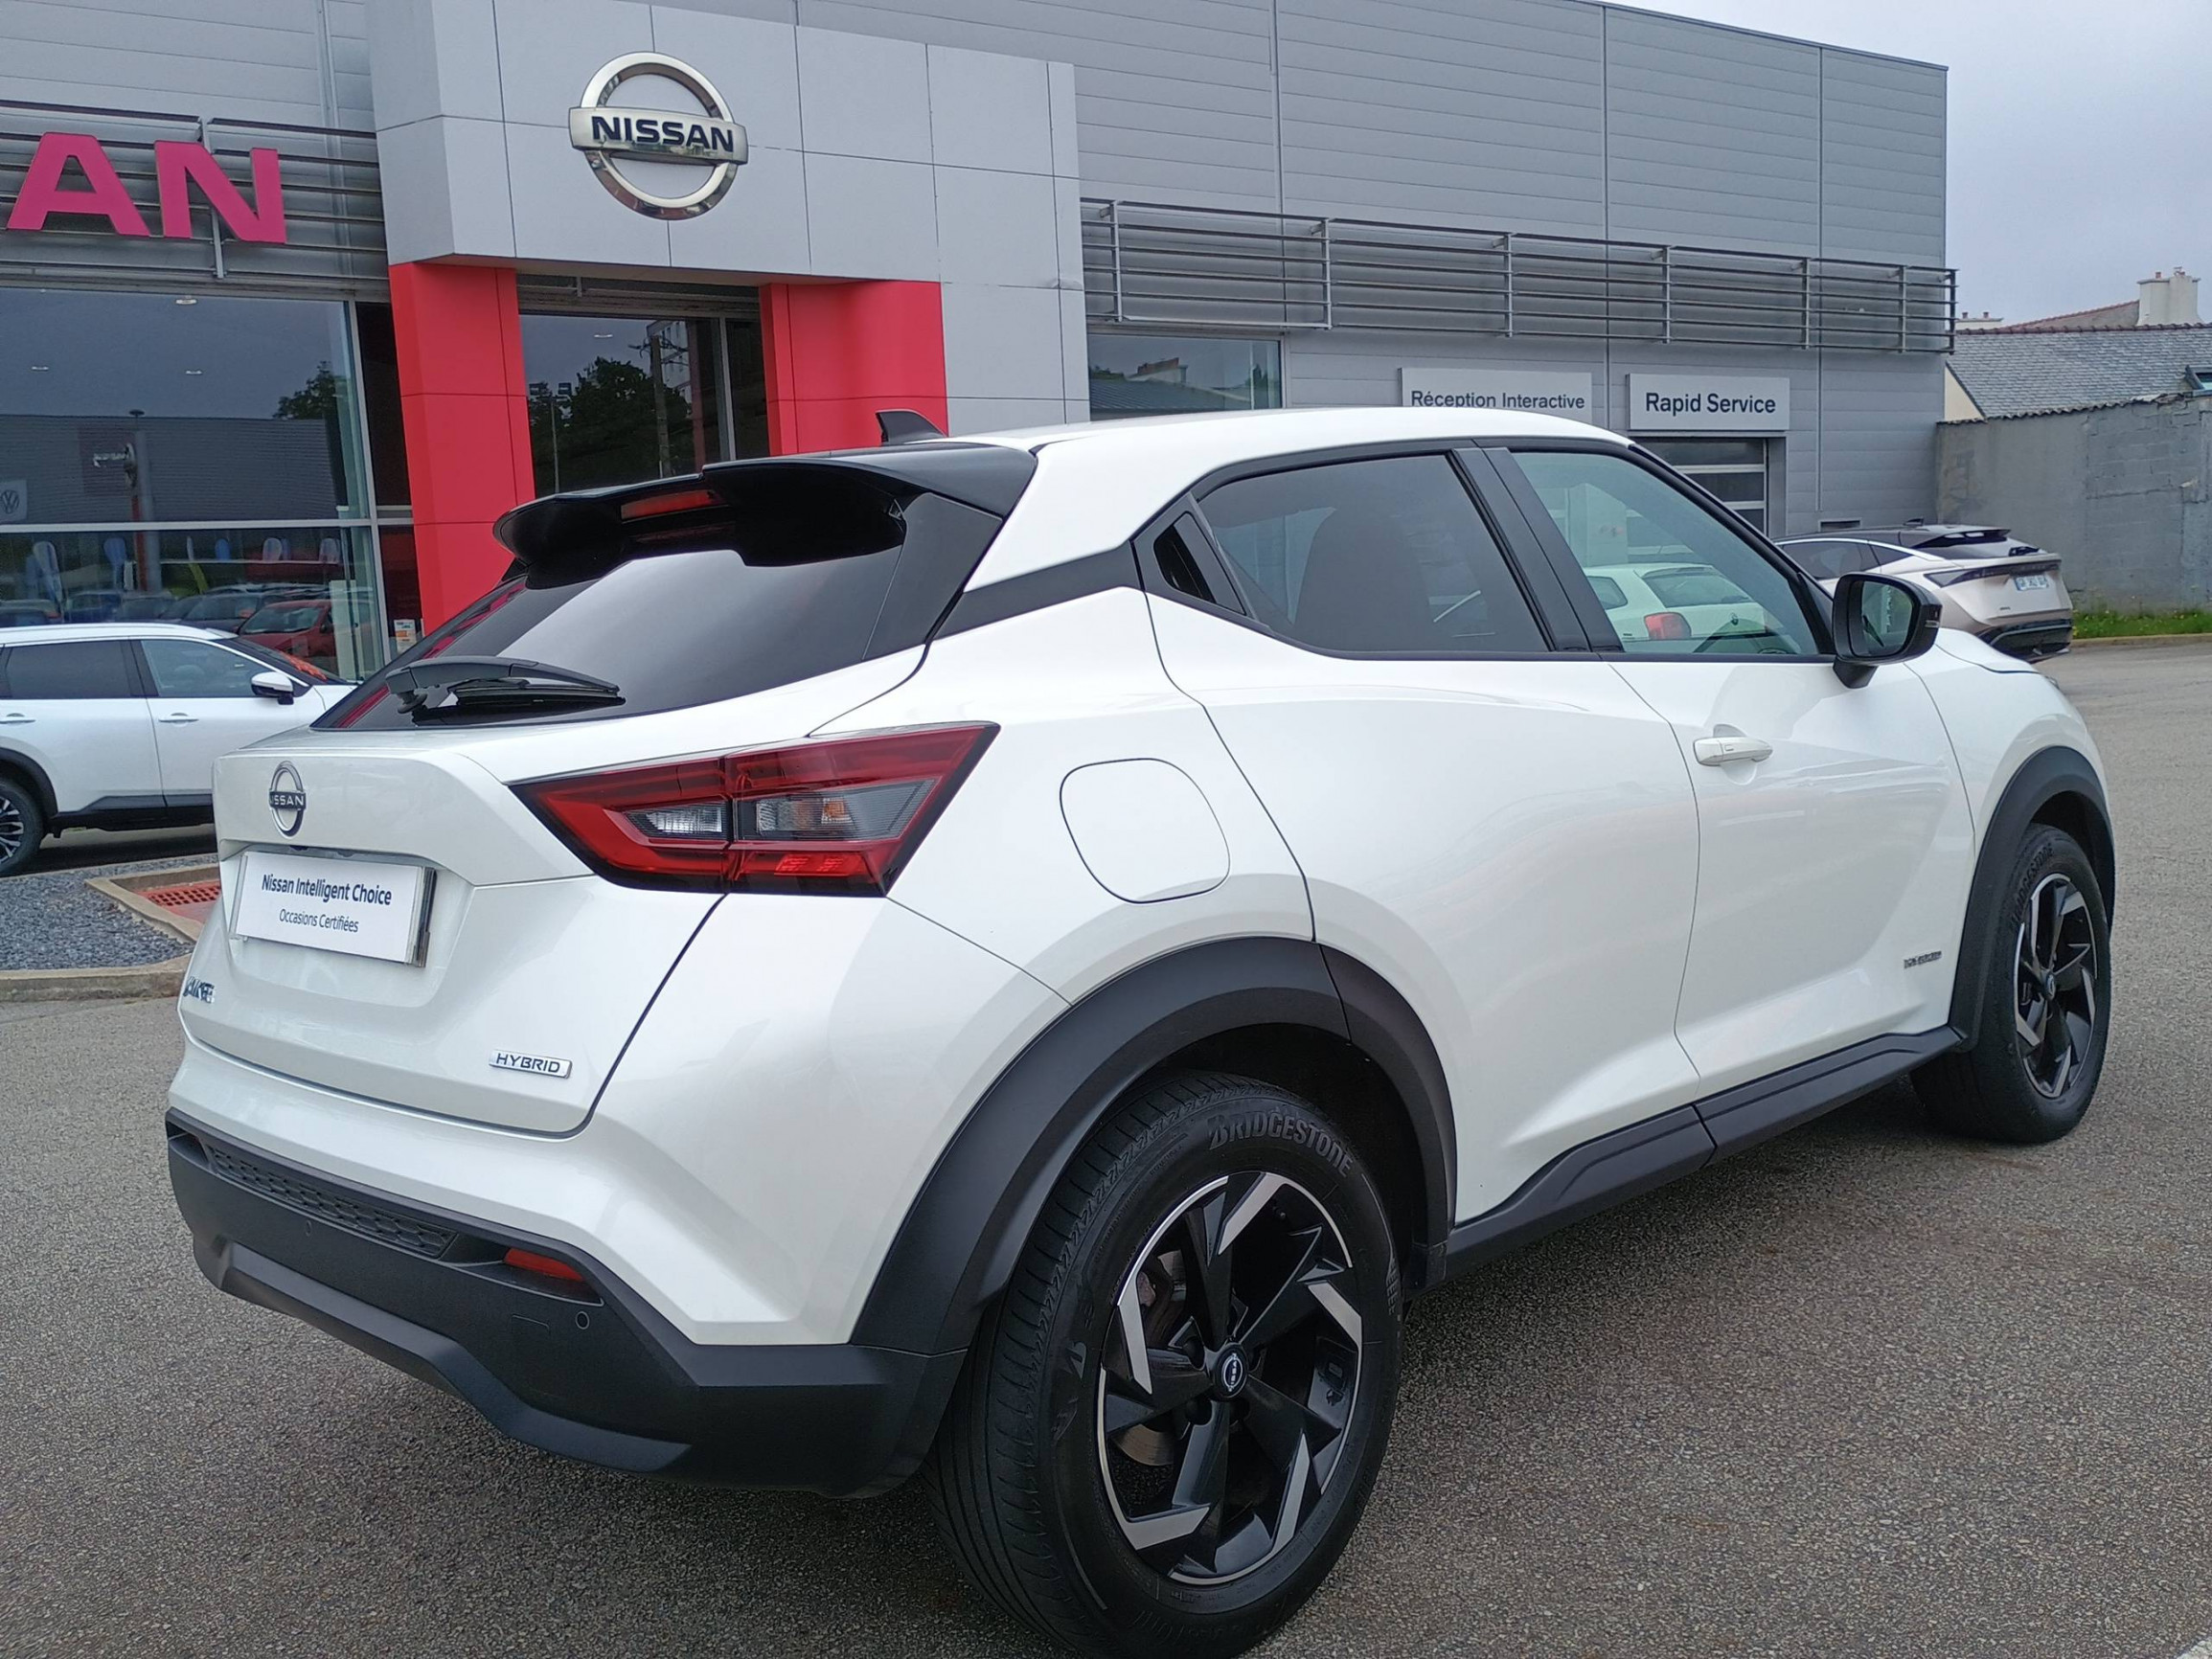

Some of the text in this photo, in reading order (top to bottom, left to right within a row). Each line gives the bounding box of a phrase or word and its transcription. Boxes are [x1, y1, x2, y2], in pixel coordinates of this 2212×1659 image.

[590, 115, 734, 152] NISSAN
[7, 131, 286, 243] AN
[1410, 390, 1585, 409] Réception Interactive
[1645, 392, 1776, 417] Rapid Service
[262, 874, 392, 905] Nissan Intelligent Choice
[279, 908, 359, 933] Occasions Certifiées
[495, 1053, 561, 1073] HYBRID
[1207, 1111, 1355, 1177] BRIDGESTONE
